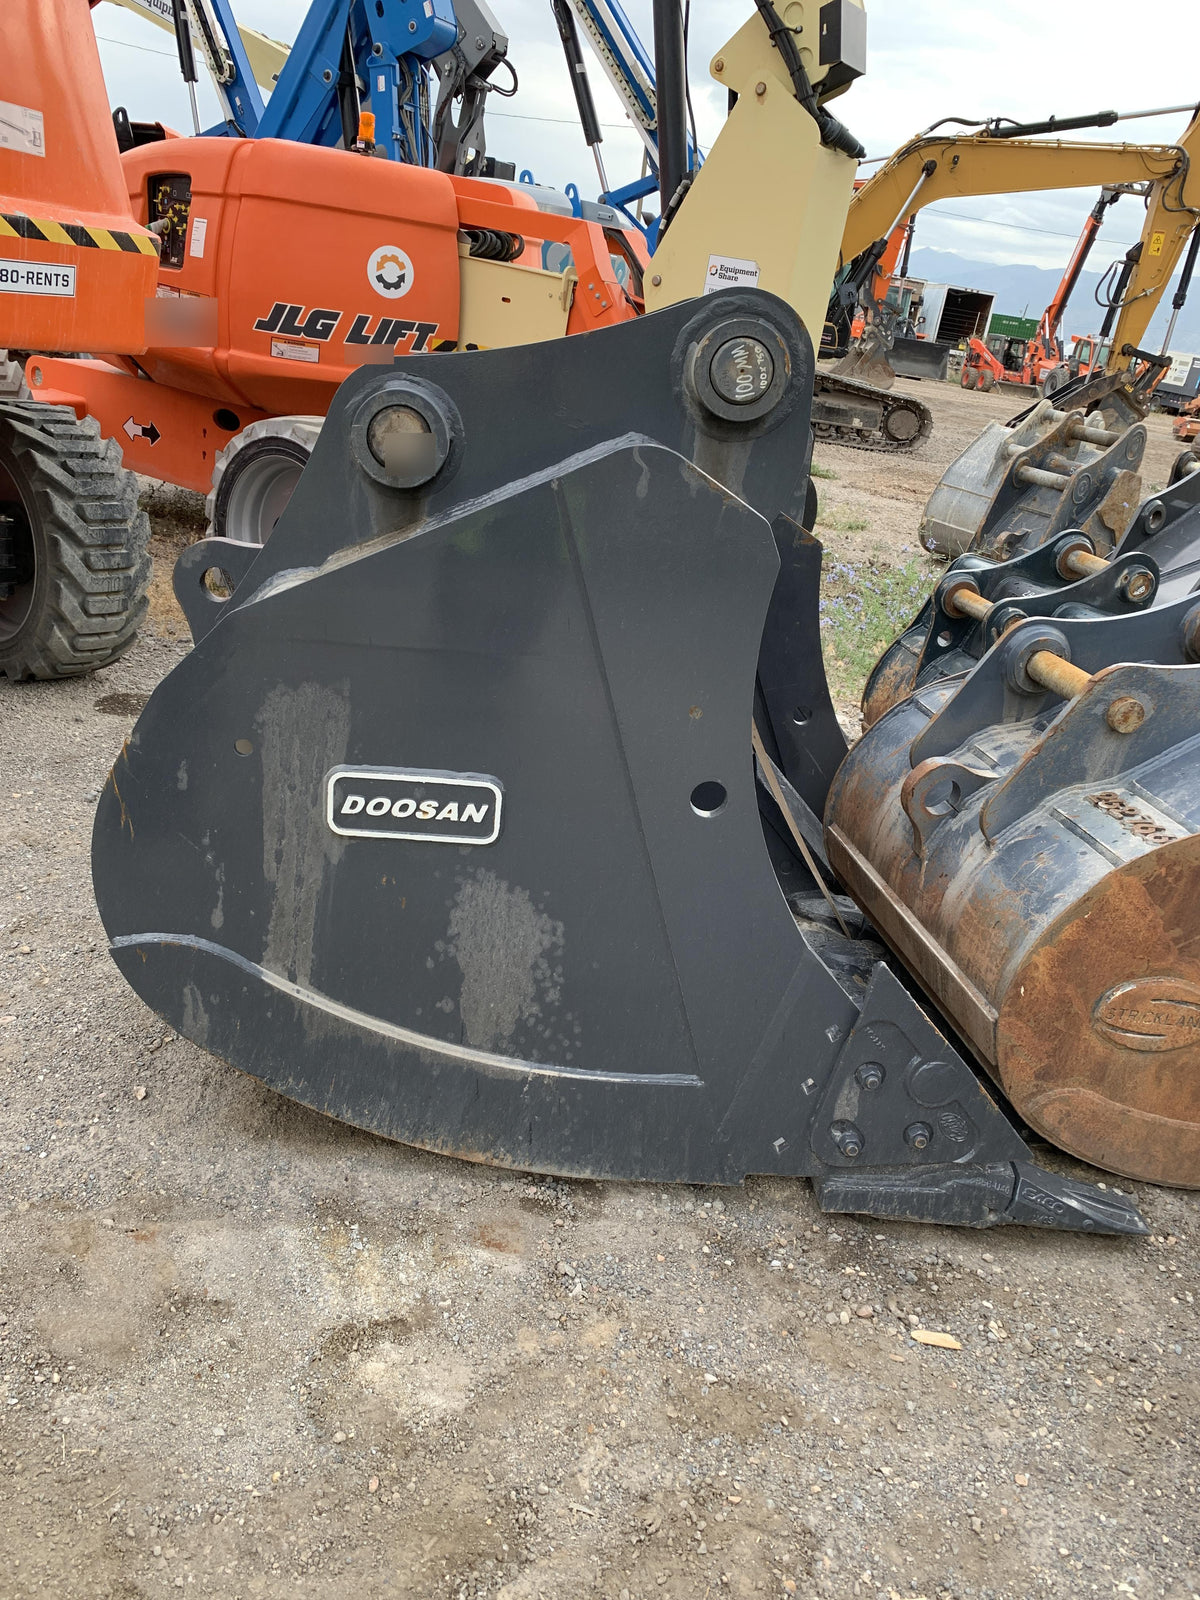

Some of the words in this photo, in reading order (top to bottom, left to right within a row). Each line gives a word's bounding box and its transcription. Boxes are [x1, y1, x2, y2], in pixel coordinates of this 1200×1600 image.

[718, 272, 739, 281] Share
[719, 264, 758, 277] Equipment
[253, 302, 343, 341] JLG
[345, 314, 439, 352] LIFT
[731, 344, 752, 369] MM
[735, 374, 755, 398] 100
[341, 795, 489, 823] DOOSAN
